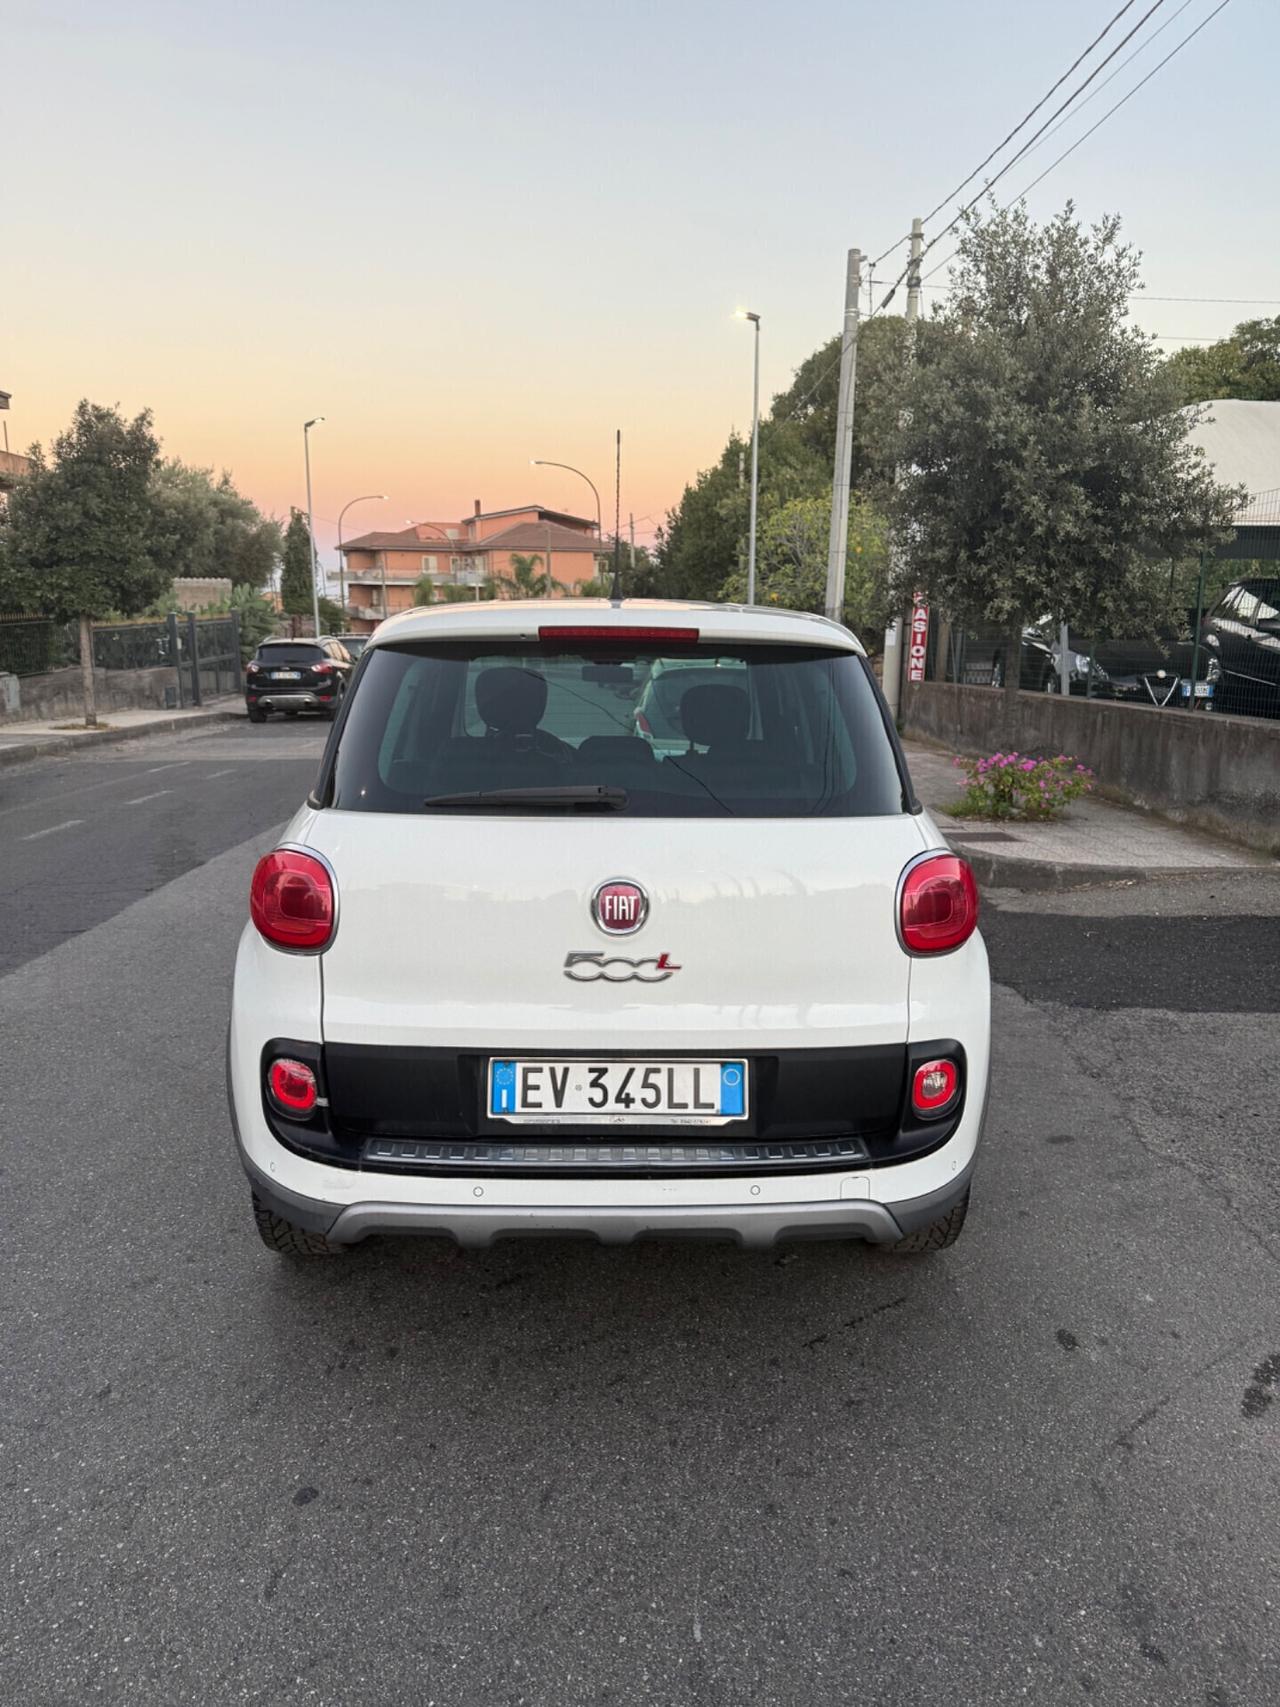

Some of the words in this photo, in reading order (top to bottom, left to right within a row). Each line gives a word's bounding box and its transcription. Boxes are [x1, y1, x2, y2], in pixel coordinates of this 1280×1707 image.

[604, 895, 638, 920] FIAT
[563, 951, 682, 982] 500L
[521, 1066, 570, 1109] EV
[587, 1066, 715, 1109] 345LL
